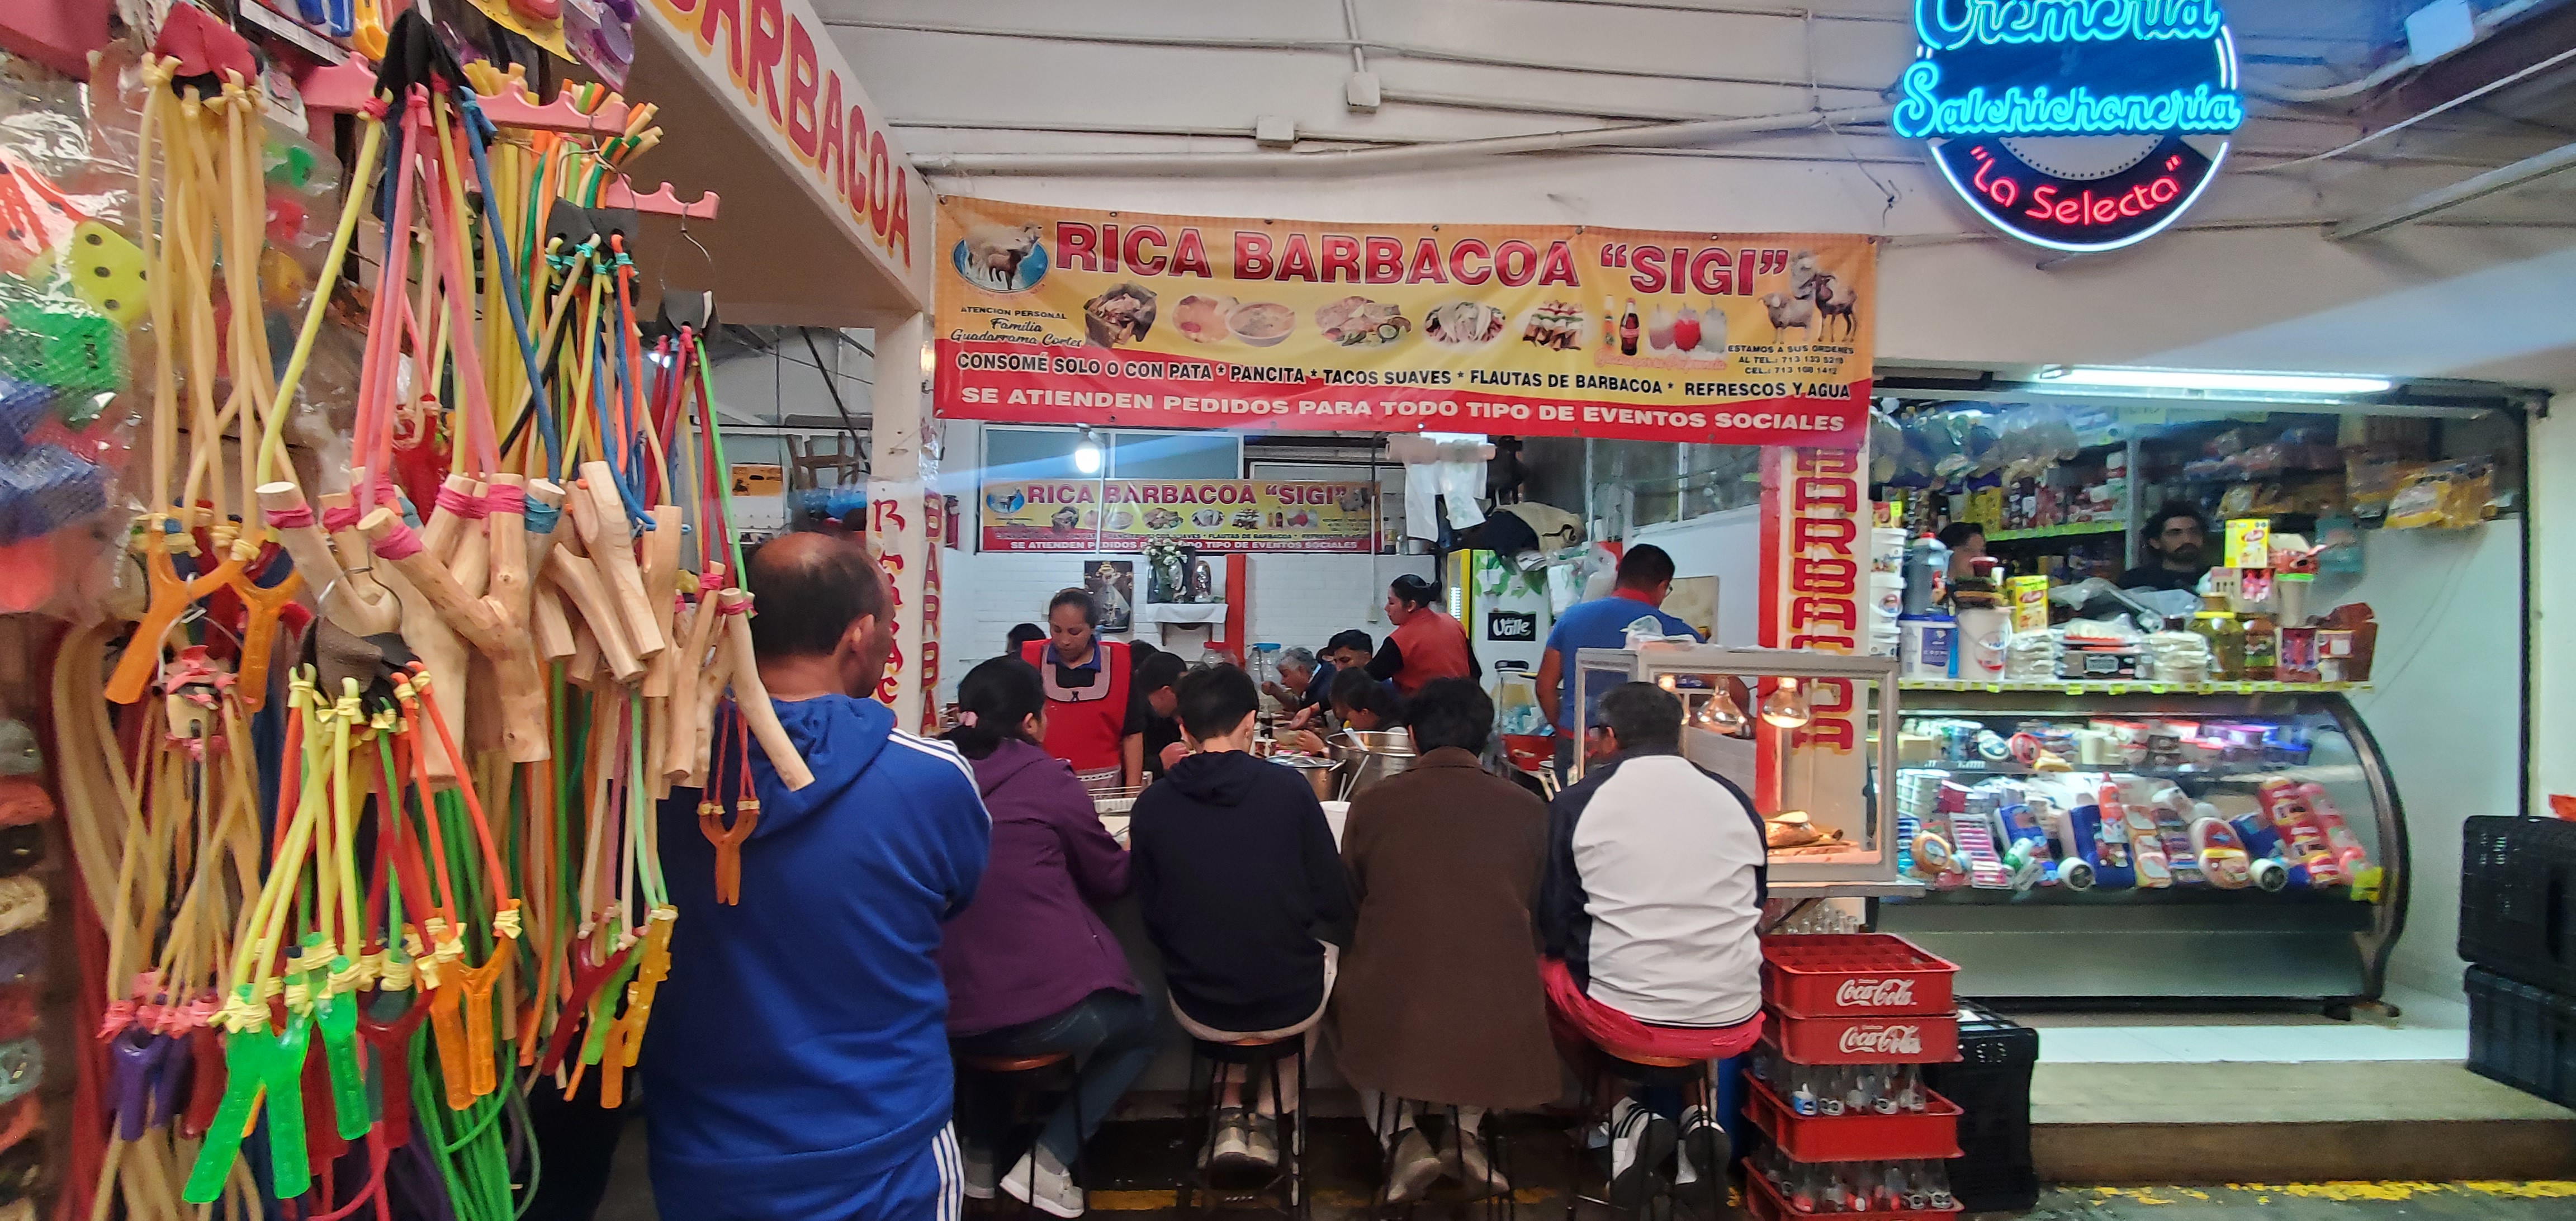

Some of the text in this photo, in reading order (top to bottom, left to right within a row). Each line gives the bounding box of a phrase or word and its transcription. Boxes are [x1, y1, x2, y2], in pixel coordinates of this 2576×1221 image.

[1893, 60, 2243, 138] Salchichoneria
[660, 0, 910, 269] RBACOA
[1055, 221, 1213, 278] RICA
[1233, 230, 1581, 287] BARBACOA
[960, 306, 1067, 320] ATENCION PERSONAL
[990, 318, 1043, 332] Familia
[950, 329, 1082, 347] Guadarrama Cortes
[1728, 344, 1774, 353] ESTAMOS
[957, 351, 1850, 399] CONSOMÉ SOLO O CON PATA PANCITA TACOS SUAVES FLAUTAS DE BARBACOA REFRESCOS Y AGUA
[962, 387, 1845, 431] SE ATIENDEN PEDIDOS PARA TODO TIPO DE EVENTOS SOCIALES
[1027, 484, 1095, 504] RICA
[1104, 484, 1257, 504] BARBACOA
[1835, 978, 1917, 1006] Coca-Cola
